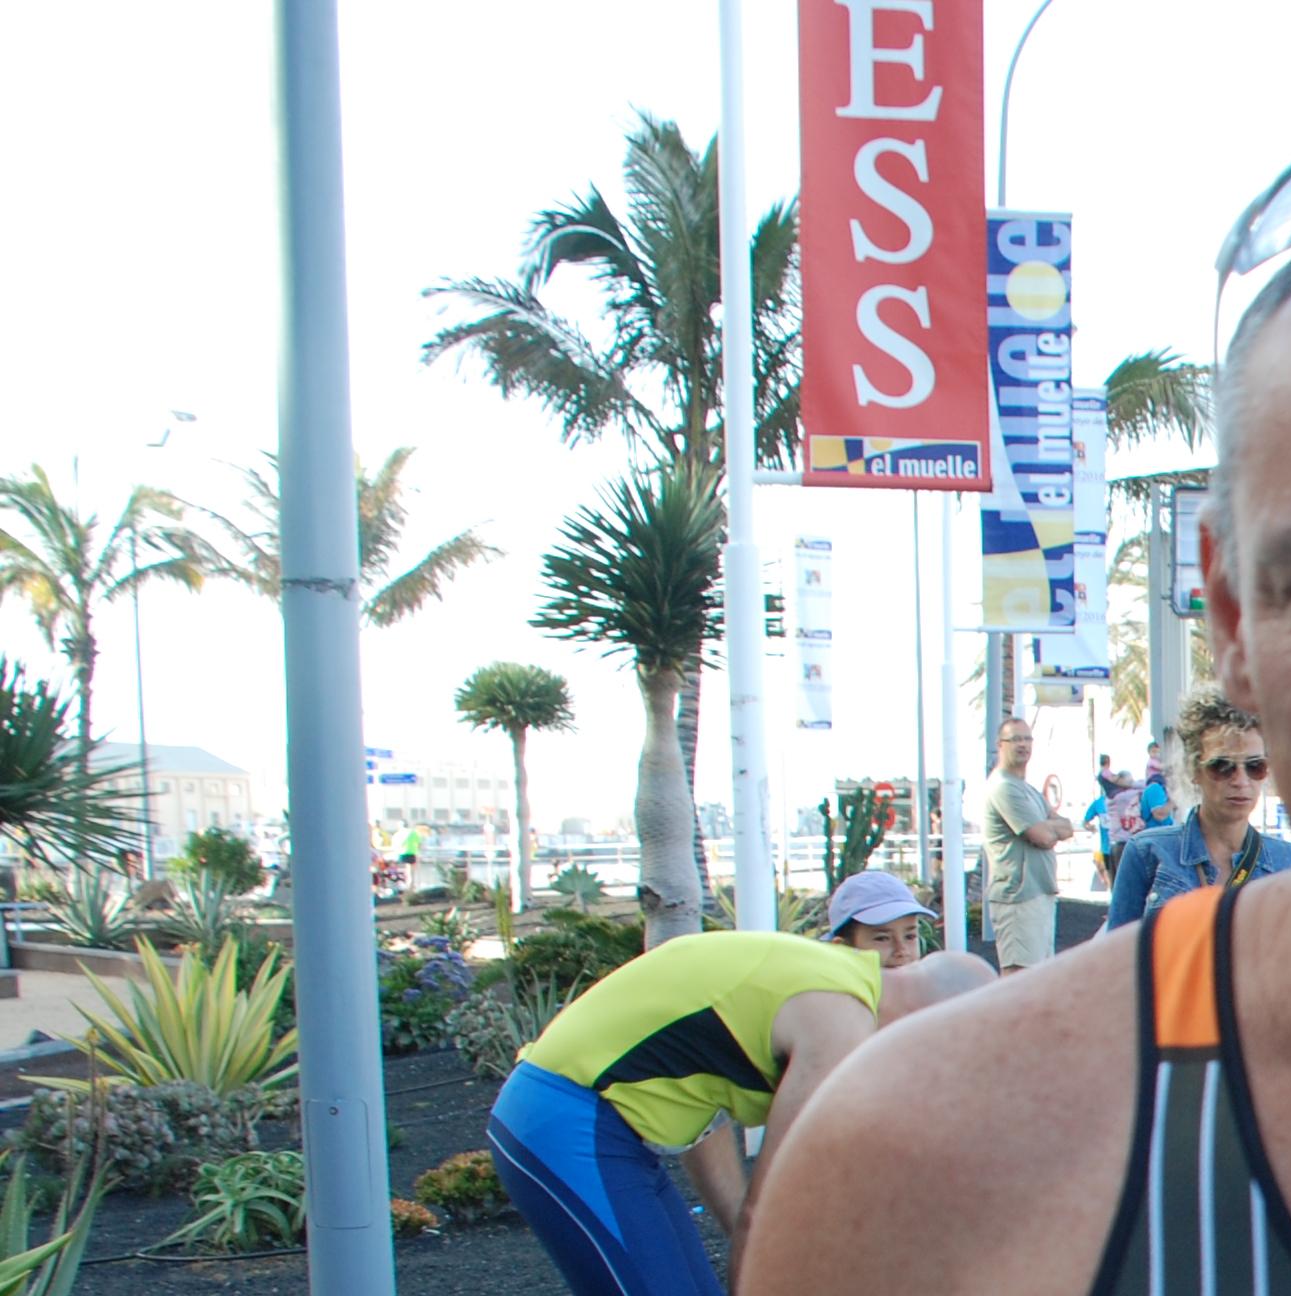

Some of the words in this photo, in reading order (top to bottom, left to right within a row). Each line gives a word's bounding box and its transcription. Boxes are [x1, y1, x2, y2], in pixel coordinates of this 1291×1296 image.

[1028, 332, 1071, 460] muelle
[871, 452, 894, 477] el
[899, 454, 976, 479] muelle
[1030, 470, 1072, 507] el
